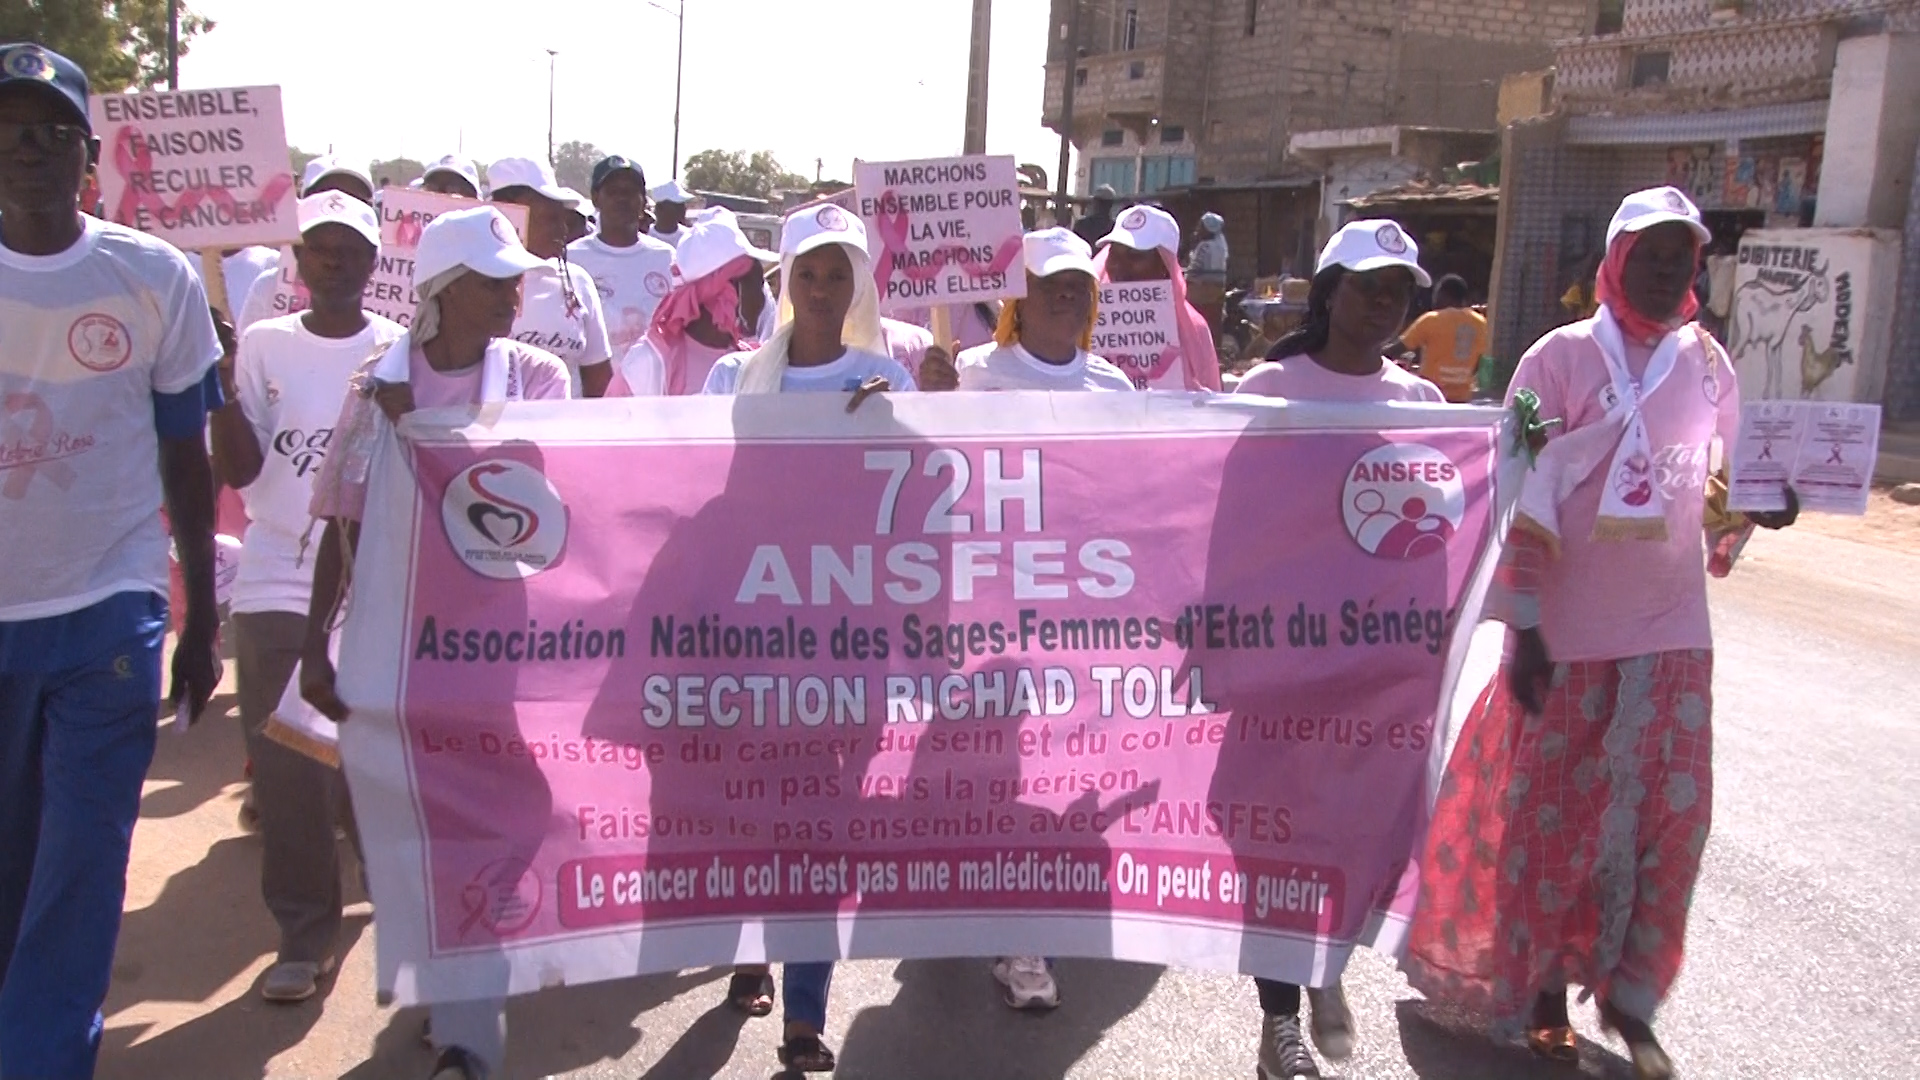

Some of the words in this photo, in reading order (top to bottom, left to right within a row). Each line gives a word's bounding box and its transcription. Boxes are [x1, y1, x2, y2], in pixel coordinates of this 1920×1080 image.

[104, 90, 258, 121] ENSEMBLE,
[129, 127, 244, 157] FAISONS
[130, 165, 255, 194] RECULER
[884, 163, 987, 186] MARCHONS
[158, 199, 278, 230] CANCER!
[862, 192, 960, 216] ENSEMBLE
[964, 189, 1013, 209] POUR
[911, 223, 935, 241] LA
[937, 220, 971, 240] VIE,
[892, 245, 993, 270] MARCHONS
[1739, 245, 1819, 271] DIBITERIE
[887, 278, 938, 299] POUR
[947, 271, 1007, 294] ELLES!
[1118, 286, 1167, 304] ROSE:
[1111, 309, 1156, 326] POUR
[1116, 353, 1161, 368] POUR
[1352, 461, 1456, 483] ANSFES
[863, 447, 1044, 535] 72H
[734, 537, 1136, 607] ANSFES
[415, 616, 626, 663] Association
[651, 614, 817, 661] Nationale
[830, 616, 890, 661] des
[903, 609, 1162, 669] Sages-Femmes
[1174, 602, 1277, 650] d'Etat
[1286, 602, 1329, 649] du
[641, 673, 866, 728] SECTION
[885, 666, 1077, 724] RICHAD
[1091, 666, 1218, 718] TOLL
[421, 728, 466, 755] Le
[480, 731, 665, 771] Dépistage
[680, 737, 722, 764] du
[737, 736, 860, 763] cancer
[874, 728, 917, 754] du
[930, 726, 1003, 754] sein
[1018, 721, 1053, 757] et
[1065, 722, 1107, 754] du
[1120, 719, 1172, 752] col
[1185, 716, 1226, 746] de
[1239, 713, 1374, 747] l'uterus
[1387, 718, 1434, 752] es
[724, 776, 765, 801] un
[780, 774, 842, 806] pas
[857, 774, 929, 802] vers
[943, 767, 975, 801] la
[989, 765, 1154, 803] guérison.
[577, 805, 714, 841] Faisons
[729, 814, 757, 838] le
[772, 812, 834, 843] pas
[848, 800, 1016, 841] ensemble
[1029, 809, 1108, 835] avec
[1121, 800, 1294, 846] L'ANSFES
[575, 864, 606, 910] Le
[612, 869, 698, 905] cancer
[706, 861, 735, 898] du
[743, 858, 780, 897] col
[788, 853, 848, 894] n'est
[857, 859, 899, 904] pas
[906, 863, 950, 892] une
[958, 852, 1108, 893] malédiction.
[1116, 852, 1149, 894] On
[1157, 859, 1213, 906] peut
[1219, 873, 1248, 905] en
[1255, 870, 1330, 919] guérir
